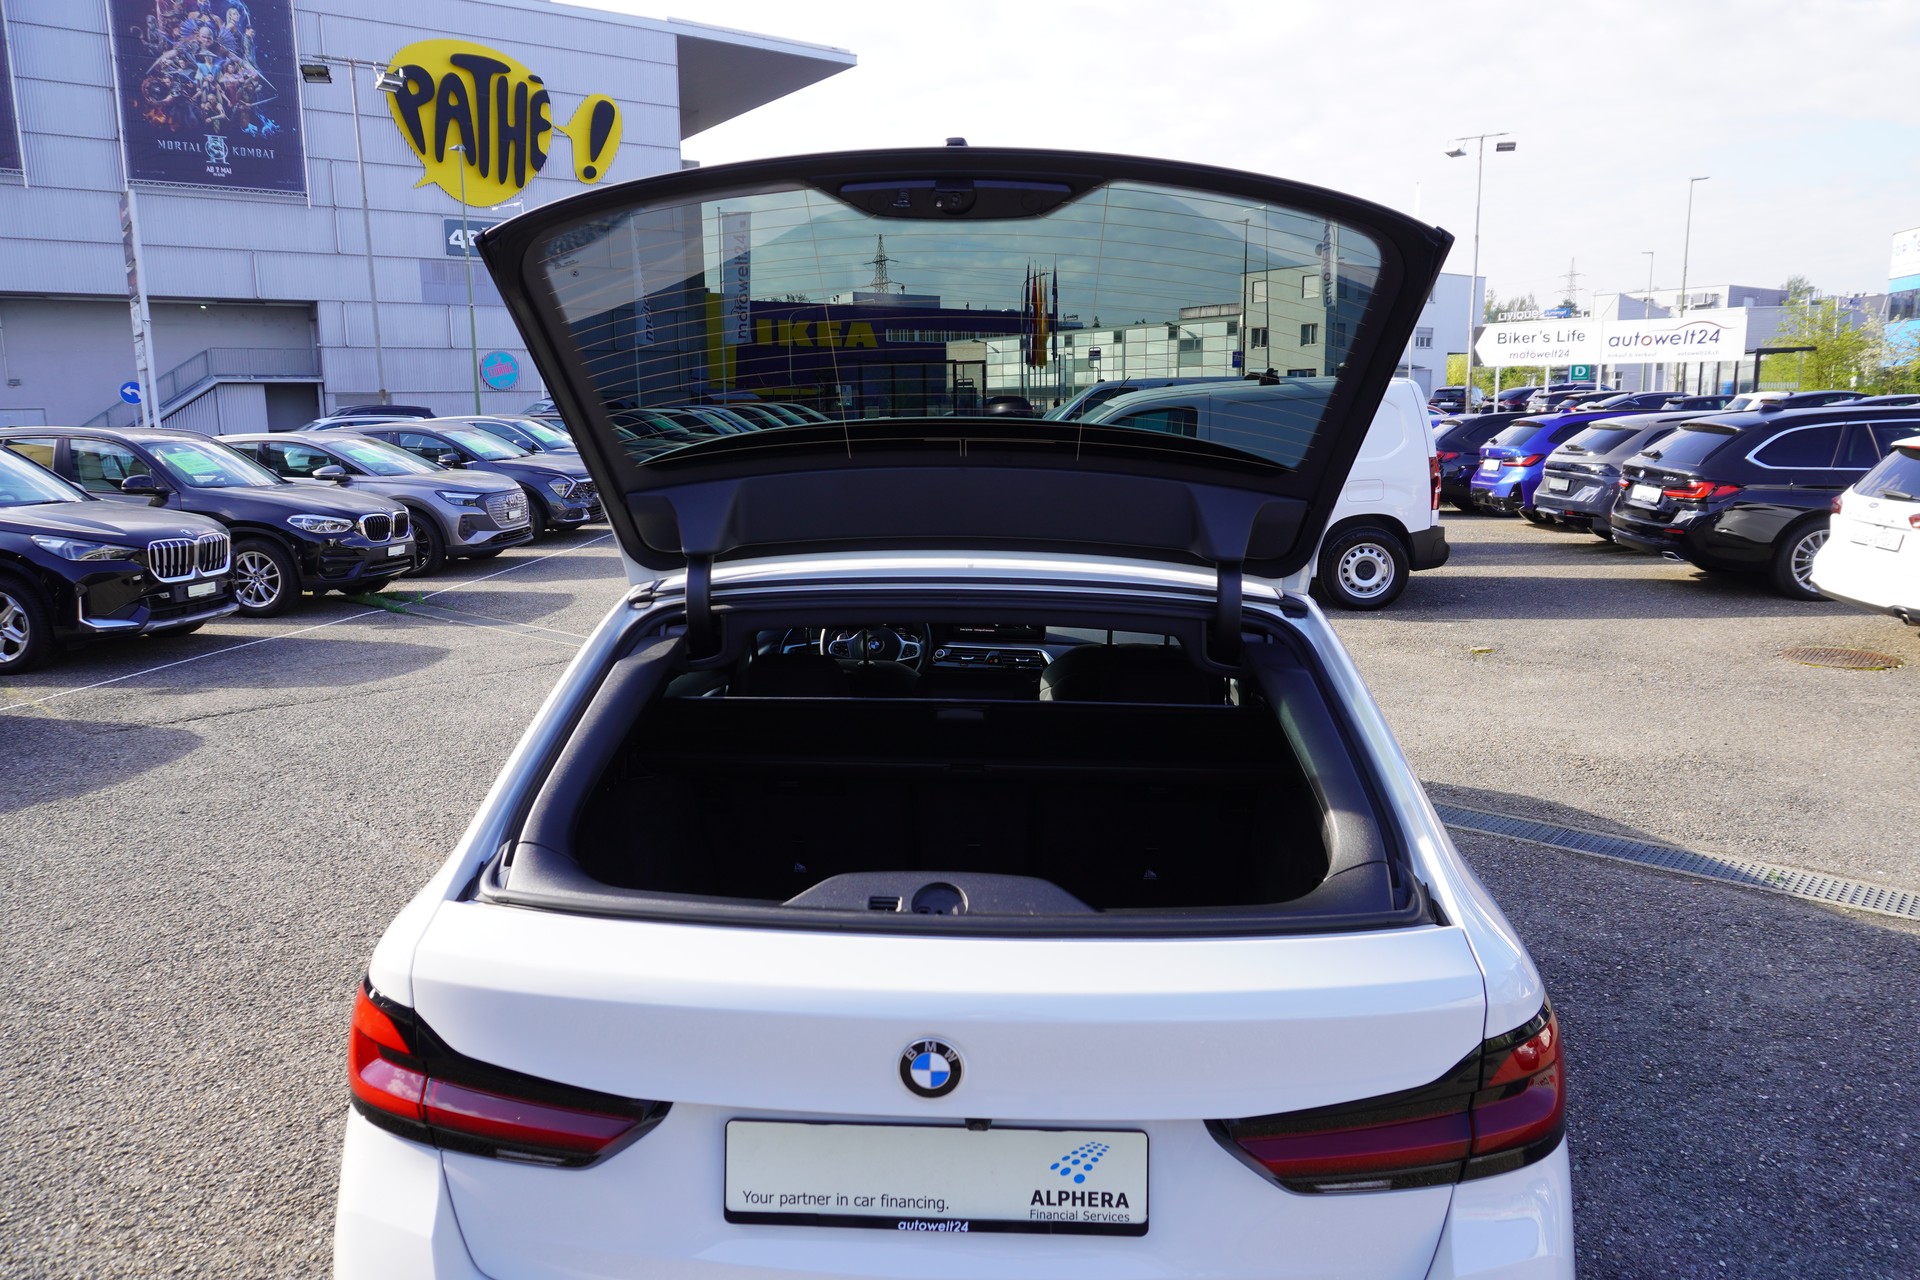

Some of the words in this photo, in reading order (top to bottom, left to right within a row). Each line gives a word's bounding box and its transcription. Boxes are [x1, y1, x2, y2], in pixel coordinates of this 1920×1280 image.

[157, 139, 201, 153] MORTAL
[232, 146, 275, 159] KOMBAT
[756, 319, 879, 348] IKEA
[1497, 330, 1551, 345] Biker's
[1557, 329, 1586, 343] Life
[1608, 328, 1721, 347] autowelt24
[1509, 349, 1570, 359] motowelt24
[1575, 366, 1587, 377] D
[905, 1041, 958, 1062] BMW
[743, 1190, 774, 1204] Your
[779, 1192, 831, 1207] partner
[836, 1193, 848, 1206] in
[853, 1195, 876, 1207] car
[881, 1194, 949, 1212] financing.
[1030, 1190, 1130, 1208] ALPHERA
[1030, 1209, 1078, 1220] Financial
[1083, 1211, 1130, 1222] Services
[898, 1220, 969, 1232] autowelt24
